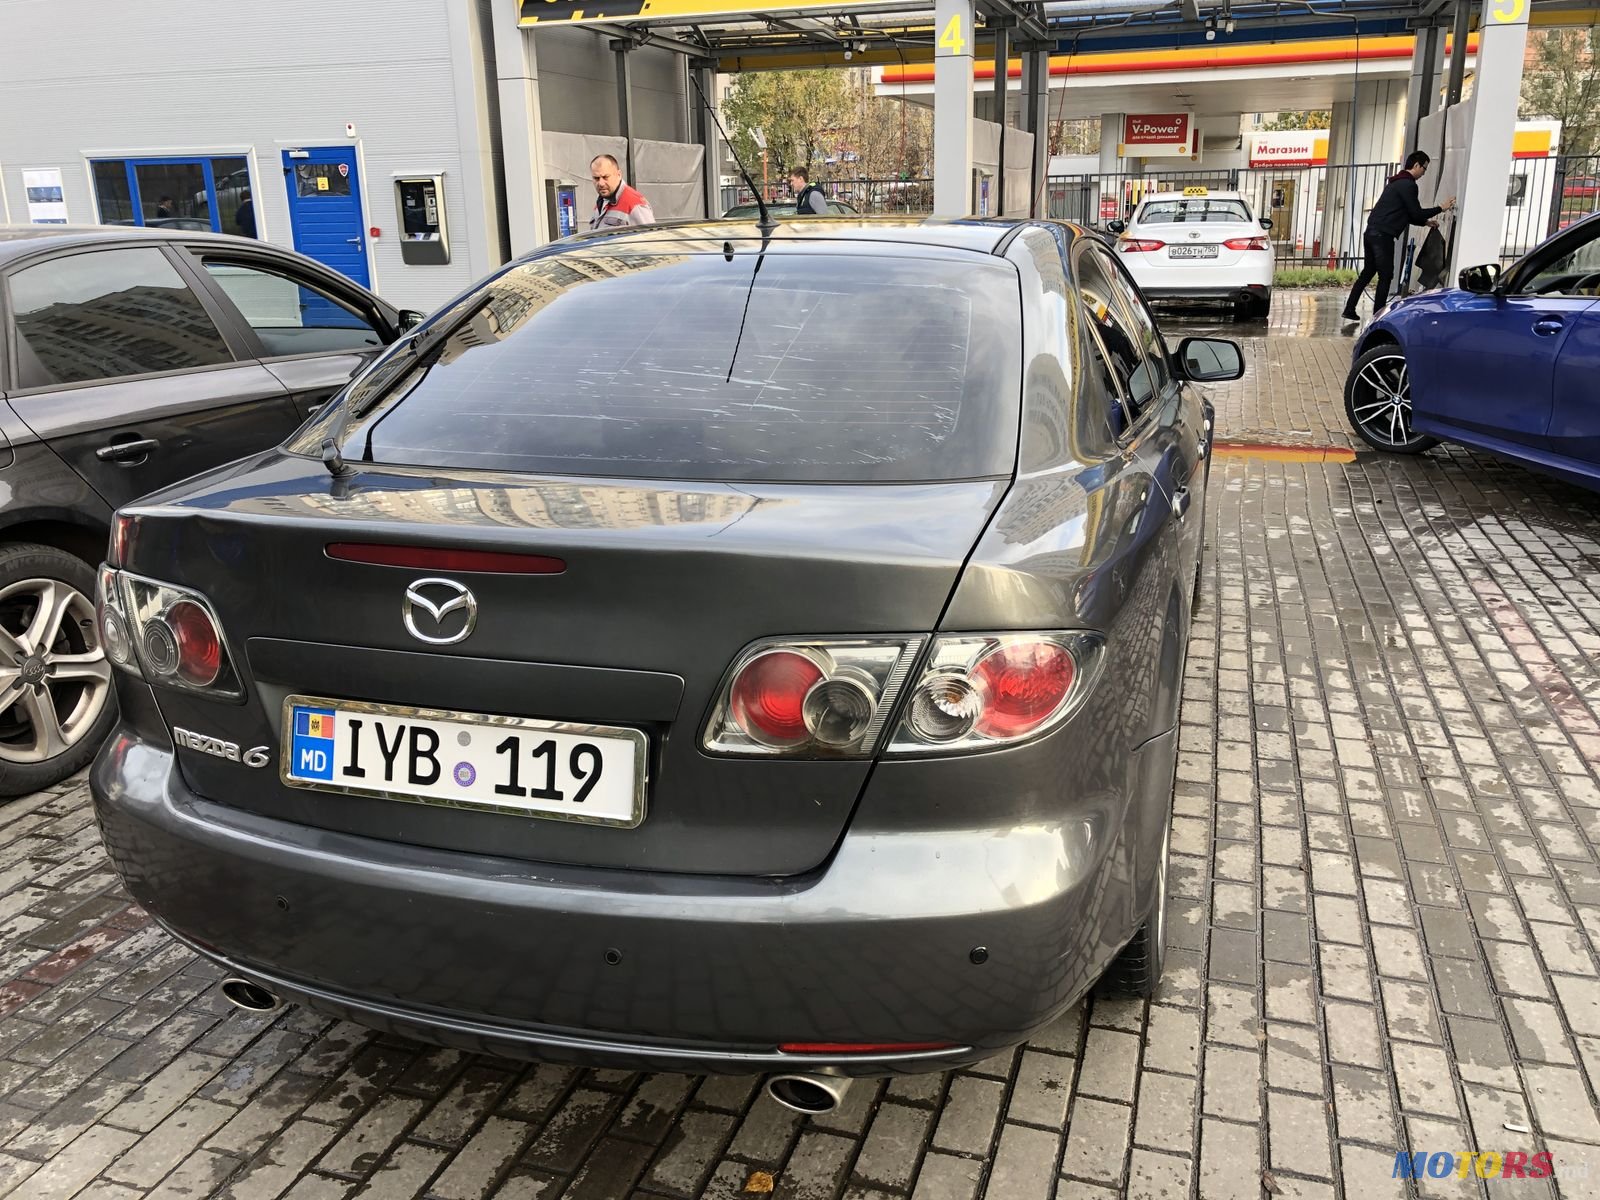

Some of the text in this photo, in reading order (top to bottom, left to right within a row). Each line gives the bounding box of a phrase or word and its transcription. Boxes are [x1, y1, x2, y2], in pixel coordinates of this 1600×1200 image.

[938, 14, 965, 56] 4
[1132, 124, 1179, 134] V-Power
[1257, 145, 1308, 154] Магазин
[242, 745, 270, 768] 6
[301, 748, 327, 772] MD
[342, 719, 603, 802] IYB 119
